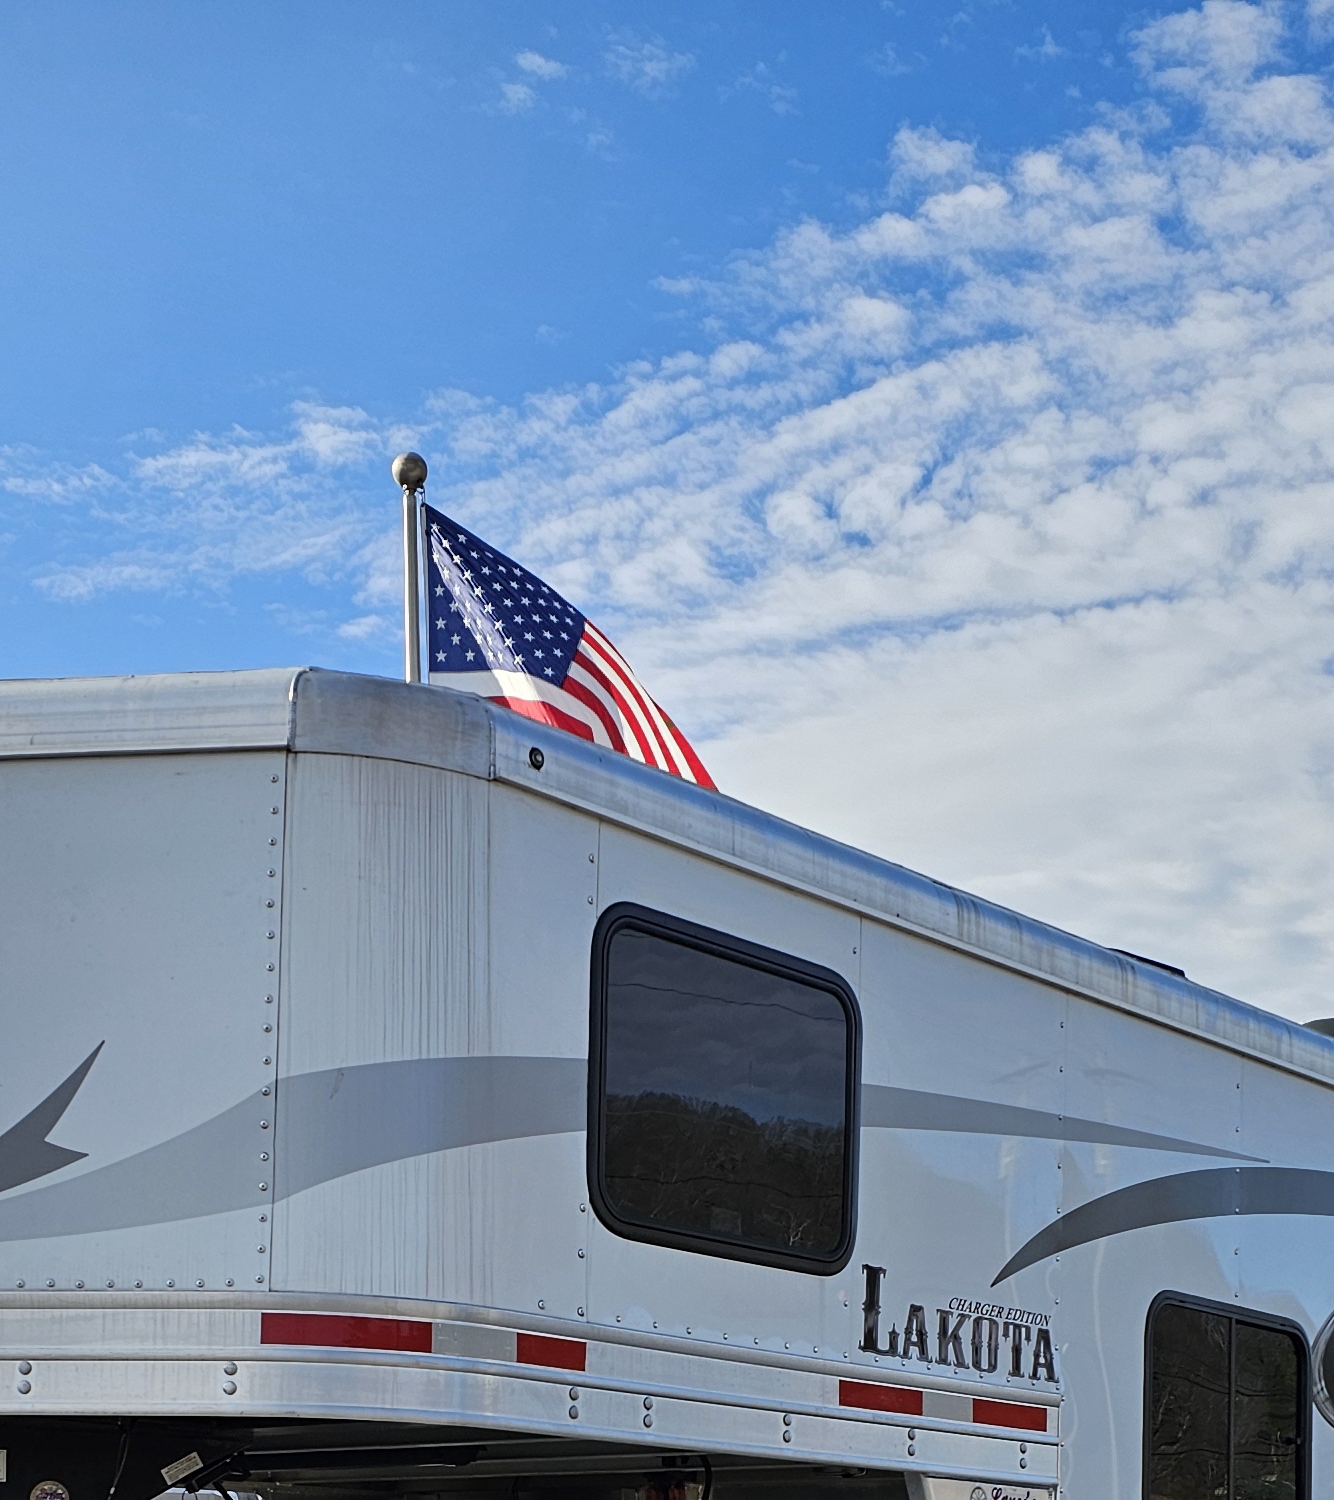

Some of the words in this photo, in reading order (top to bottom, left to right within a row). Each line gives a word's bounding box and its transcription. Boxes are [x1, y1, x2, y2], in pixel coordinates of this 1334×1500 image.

[858, 1264, 1060, 1383] LAKOTA
[948, 1297, 1004, 1319] CHARGER
[1005, 1307, 1051, 1327] EDITION
